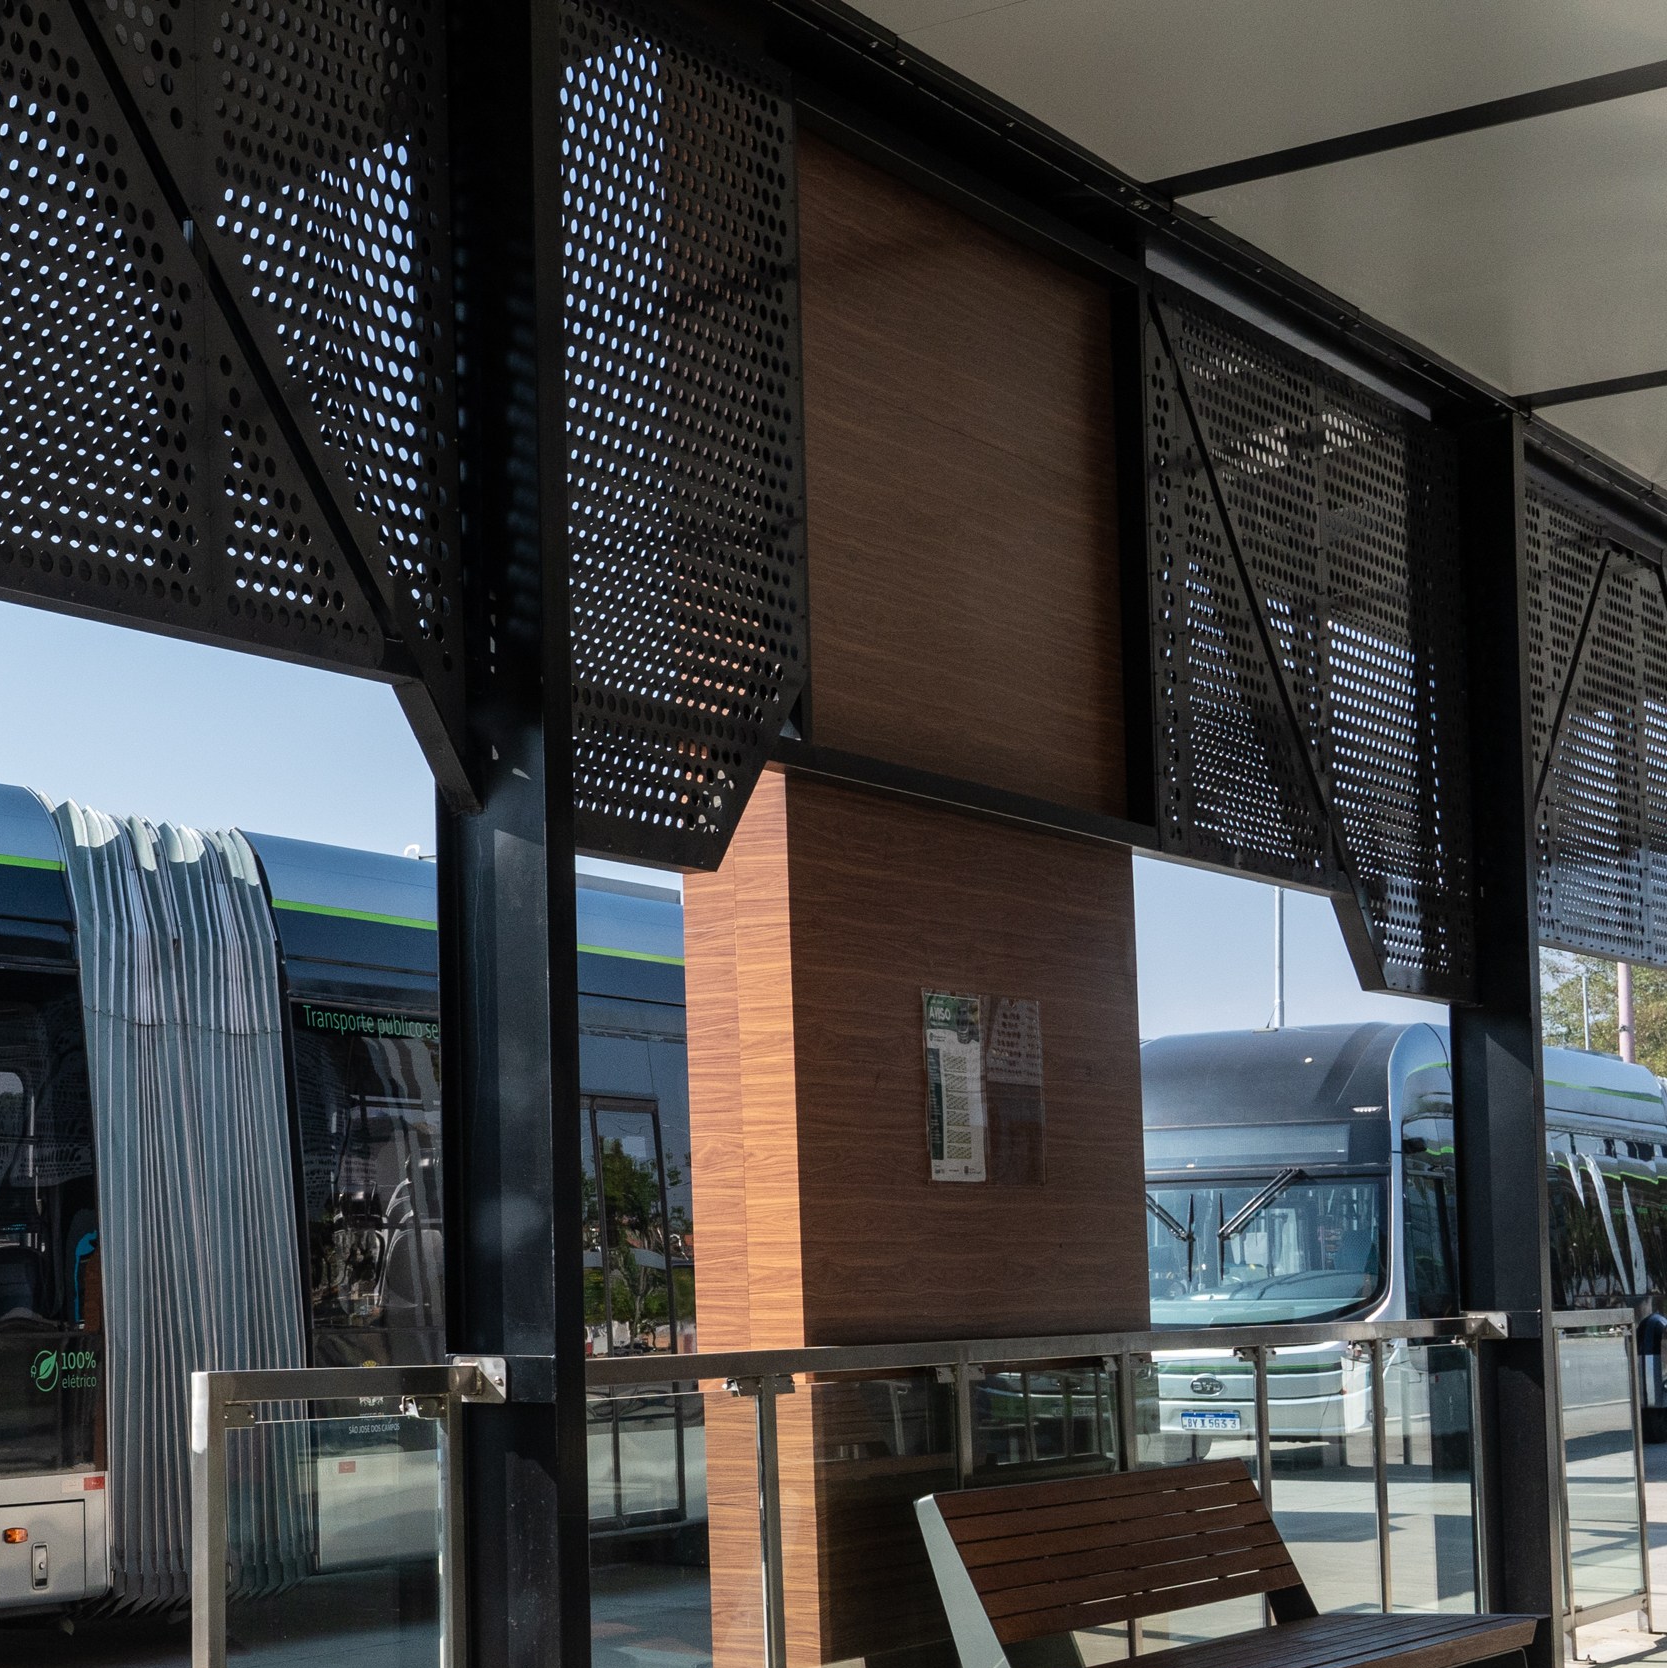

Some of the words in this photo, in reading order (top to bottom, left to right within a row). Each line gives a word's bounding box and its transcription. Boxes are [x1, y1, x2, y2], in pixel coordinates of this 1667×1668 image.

[302, 1004, 375, 1037] Transporte
[378, 1013, 423, 1041] público
[425, 1022, 439, 1040] se
[61, 1351, 97, 1370] 100%
[62, 1374, 97, 1389] elétrico
